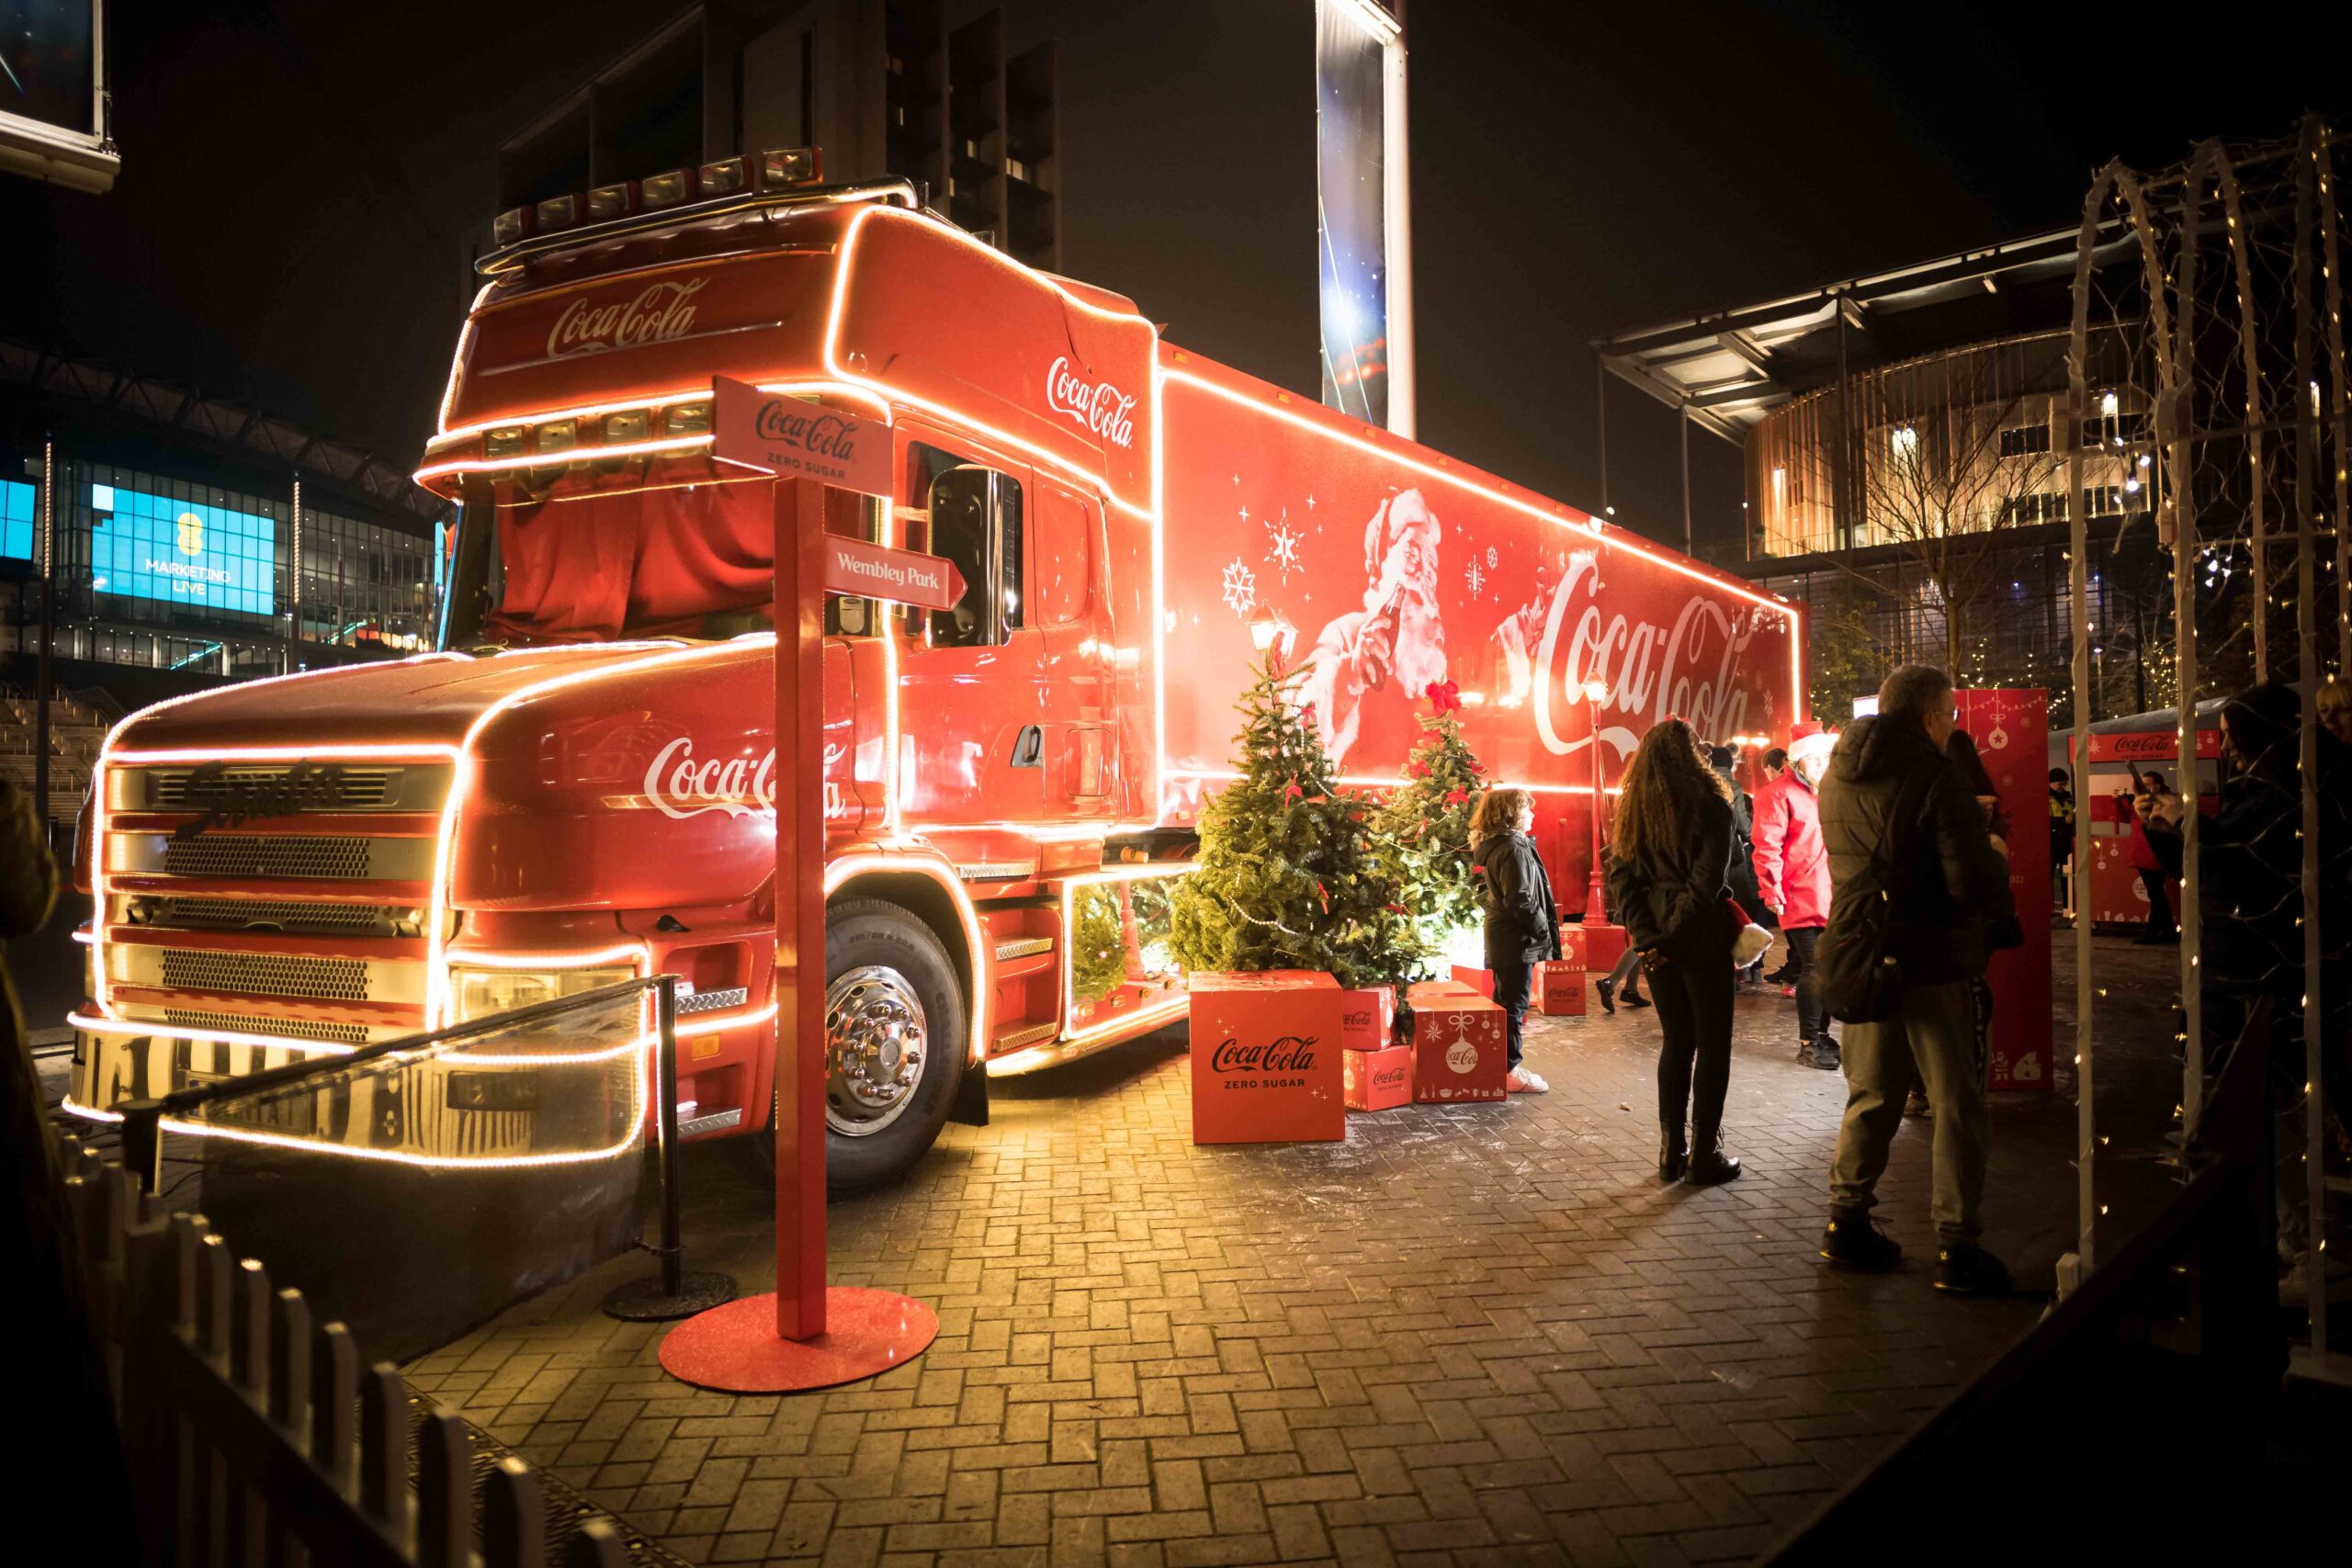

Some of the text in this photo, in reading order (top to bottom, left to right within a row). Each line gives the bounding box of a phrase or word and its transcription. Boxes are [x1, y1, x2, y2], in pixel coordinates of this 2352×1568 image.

[547, 276, 711, 358] Coca-Cola
[1046, 356, 1138, 447] Coca-Cola
[756, 400, 858, 460] Coca-Cola
[767, 452, 844, 479] ZERO SUGAR
[145, 558, 230, 582] MARKETING
[173, 579, 206, 595] LIVE
[837, 552, 939, 589] Wembley Park
[1533, 557, 1757, 763] Coca-Cola
[643, 737, 847, 819] Coca-Ca
[1212, 1036, 1320, 1073] Coca-Cola
[1225, 1079, 1305, 1089] ZERO SUGAR
